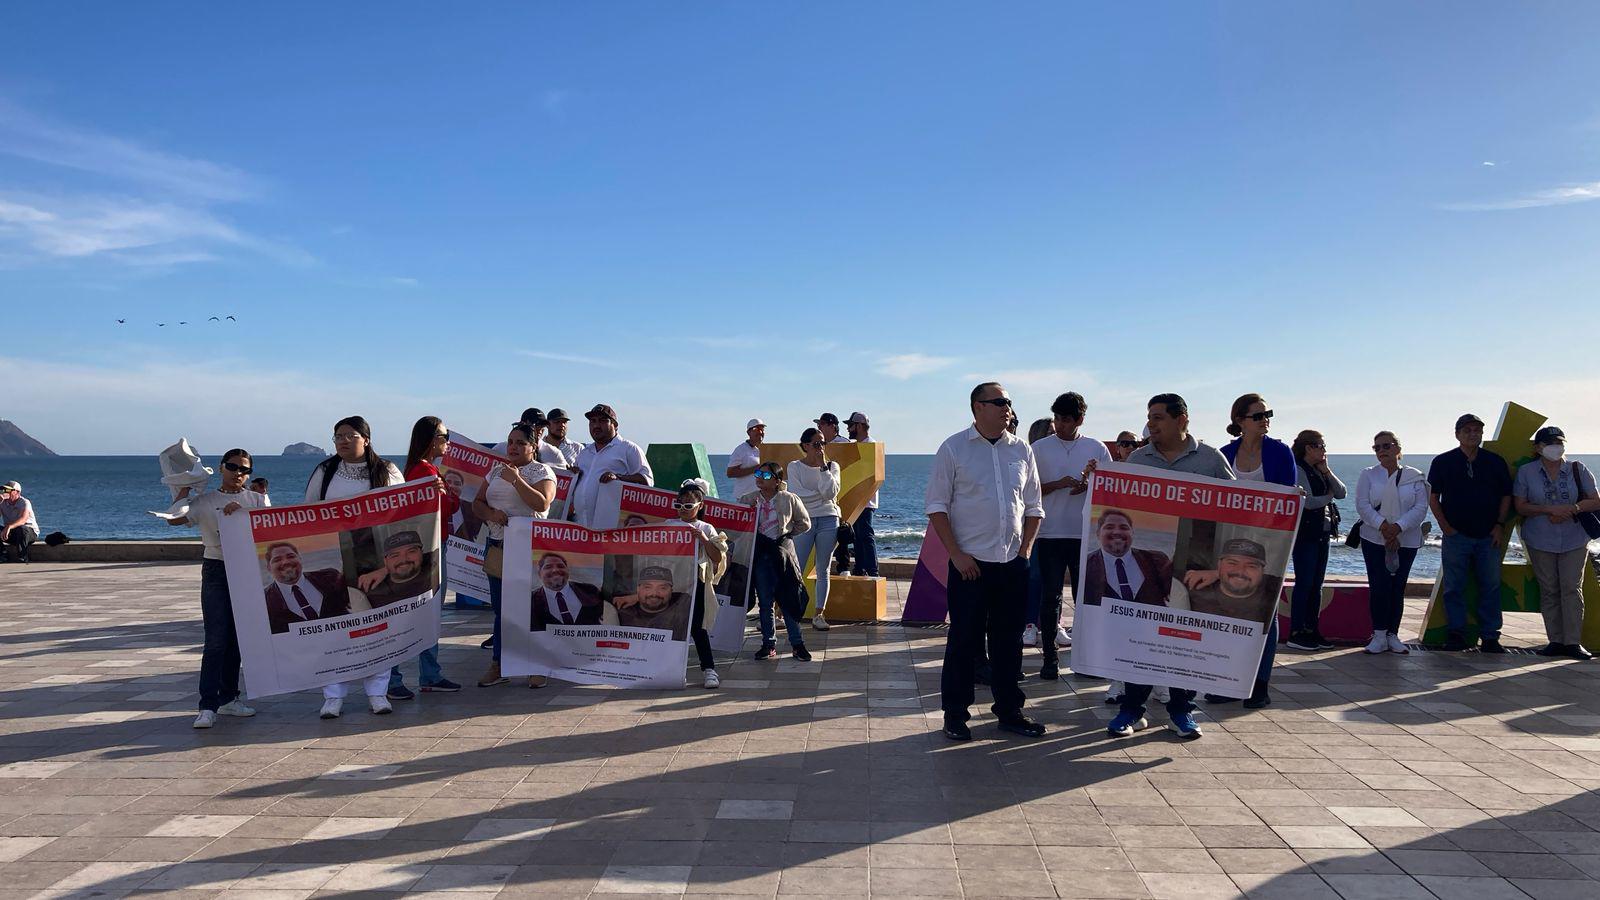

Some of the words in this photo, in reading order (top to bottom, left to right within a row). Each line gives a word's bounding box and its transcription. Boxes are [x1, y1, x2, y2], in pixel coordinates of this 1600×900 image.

[446, 445, 490, 468] PRIVADO
[623, 489, 668, 507] PRIVADO
[1095, 475, 1161, 499] PRIVADO
[1166, 485, 1186, 502] DE
[1191, 489, 1212, 505] SU
[1217, 491, 1296, 516] LIBERTAD
[252, 509, 317, 529] PRIVADO
[320, 507, 340, 520] DE
[343, 502, 362, 518] SU
[366, 486, 435, 513] LIBERTAD
[533, 525, 588, 542] PRIVADO
[592, 532, 608, 542] DE
[612, 532, 628, 542] SU
[632, 530, 692, 544] LIBERTAD
[454, 541, 477, 554] ANTONIO
[299, 626, 323, 636] JESUS
[325, 618, 360, 632] ANTONIO
[362, 604, 408, 625] HERNANDEZ
[410, 597, 427, 610] RUIZ
[1110, 605, 1134, 617] JESUS
[1136, 609, 1174, 623] ANTONIO
[1176, 616, 1230, 632] HERNANDEZ
[1232, 625, 1253, 636] RUIZ
[553, 628, 575, 637] JESUS
[577, 629, 608, 638] ANTONIO
[610, 630, 650, 640] HERNANDEZ
[650, 633, 666, 642] RUIZ
